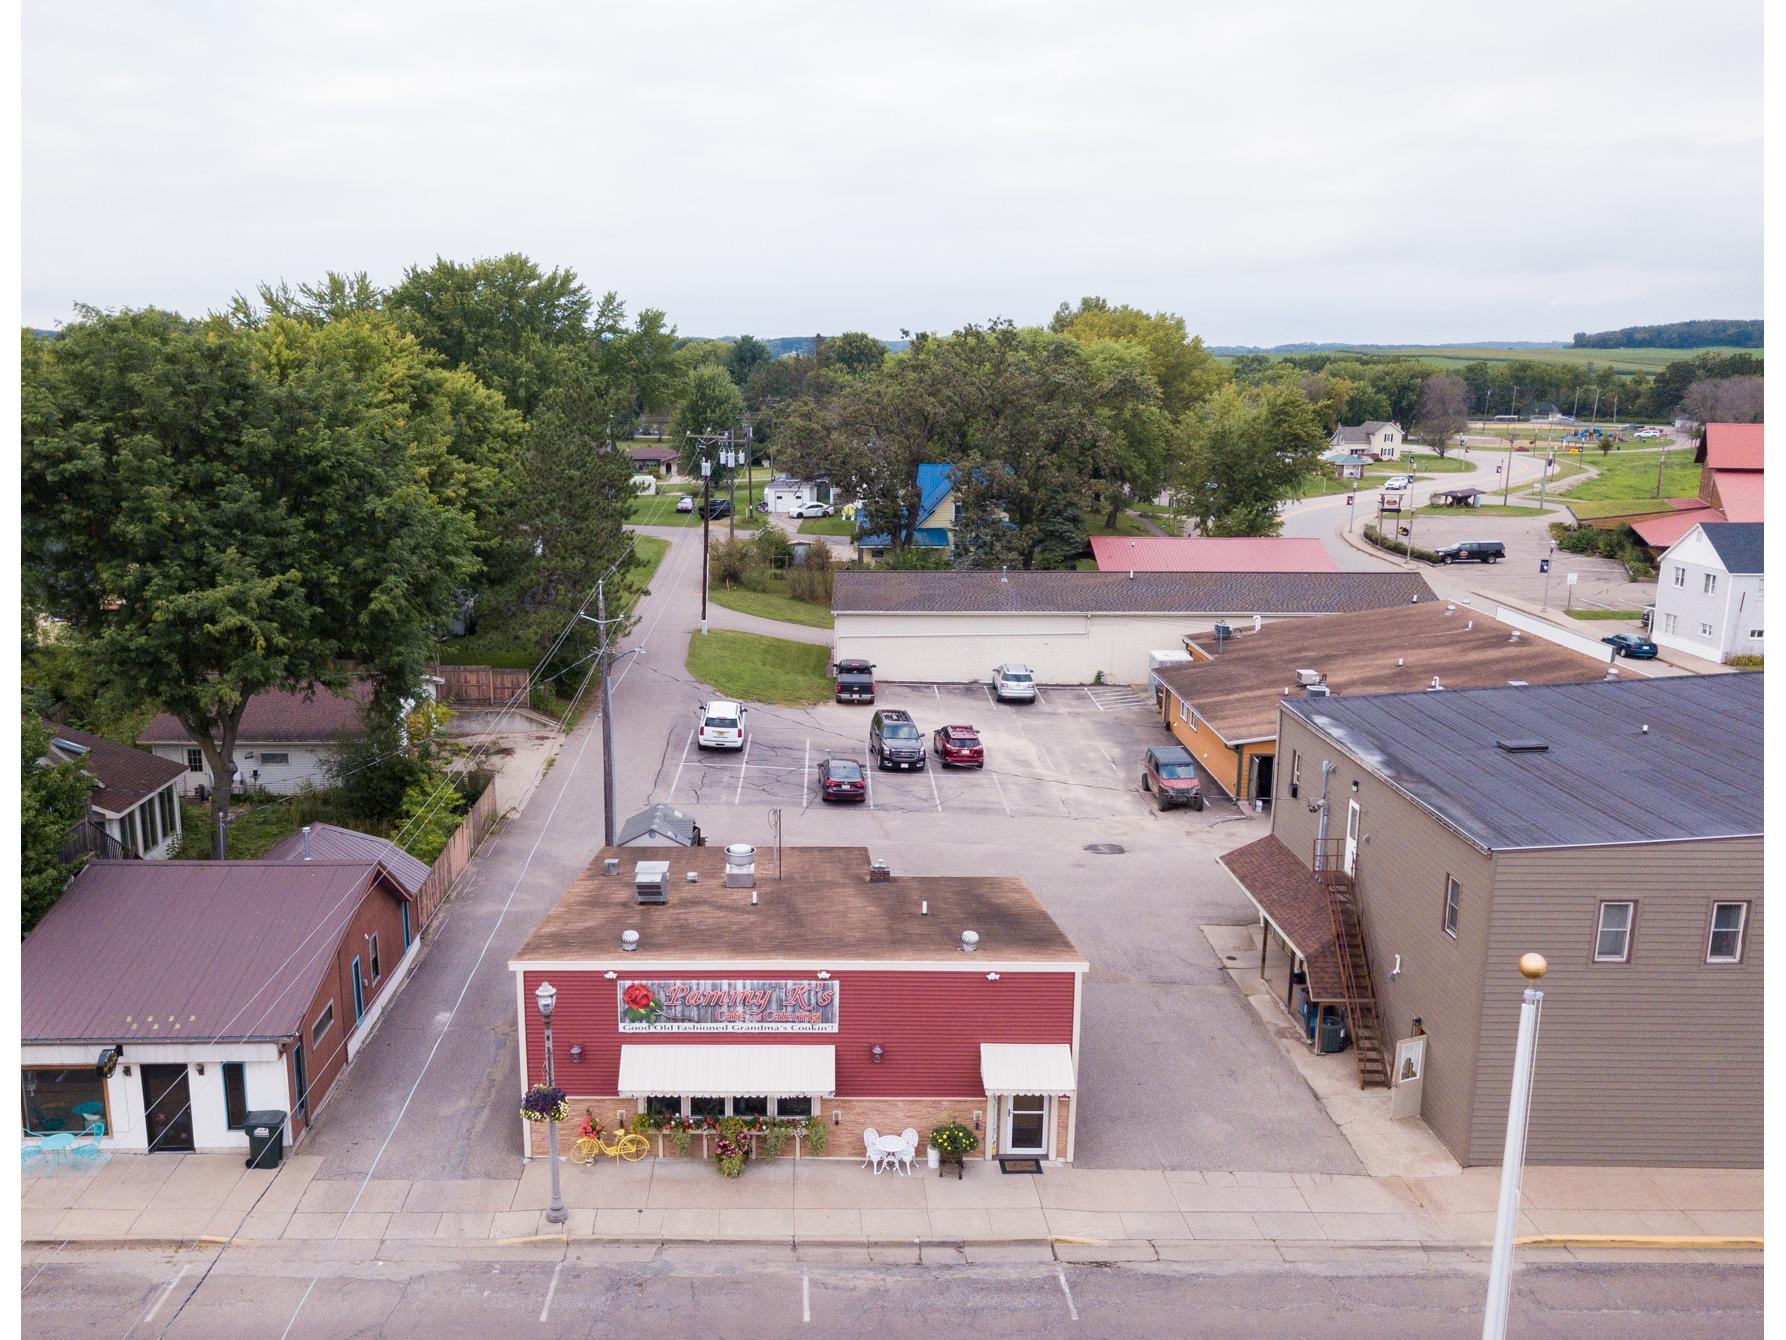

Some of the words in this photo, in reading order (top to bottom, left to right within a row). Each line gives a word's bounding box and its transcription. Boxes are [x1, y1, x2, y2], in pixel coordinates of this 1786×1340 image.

[664, 984, 772, 1014] Pammy
[783, 982, 833, 1011] K's
[763, 1009, 821, 1024] Catering
